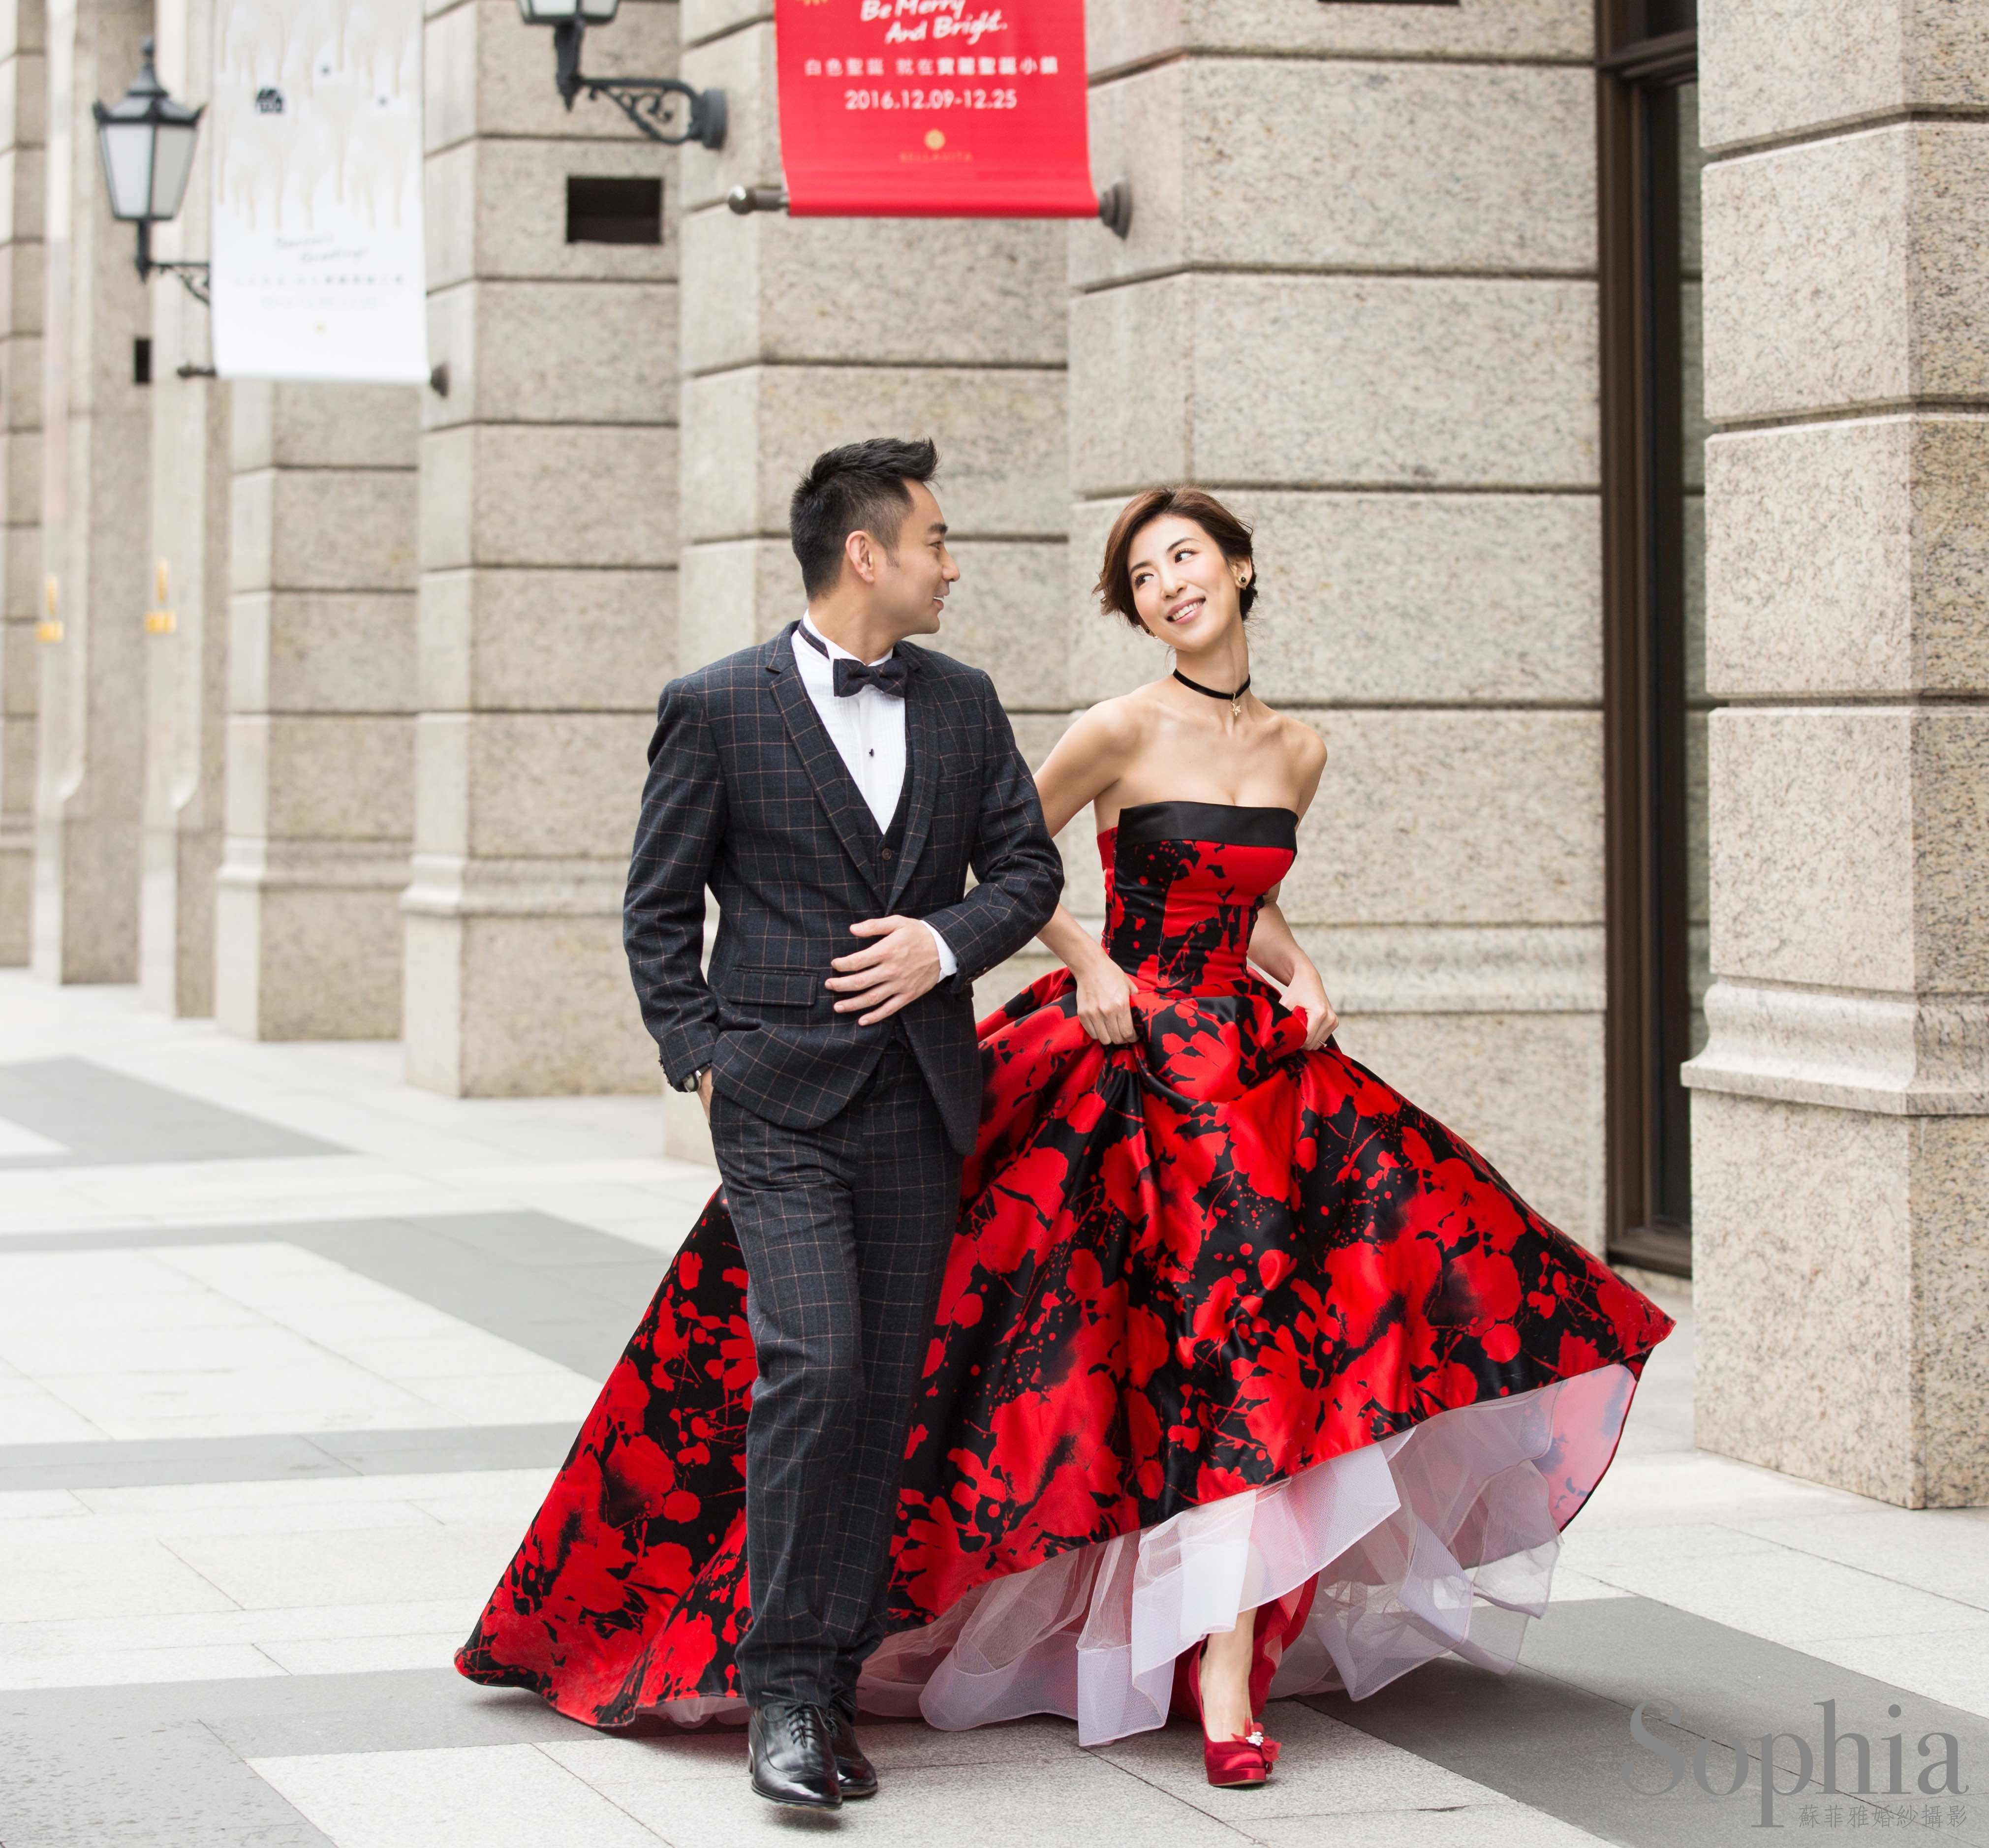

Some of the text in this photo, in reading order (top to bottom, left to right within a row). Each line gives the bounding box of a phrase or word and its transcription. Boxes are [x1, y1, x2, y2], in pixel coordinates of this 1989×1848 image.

[861, 0, 966, 21] Be Merry
[885, 21, 927, 44] And
[844, 89, 1017, 110] 2016.12.09-12.25
